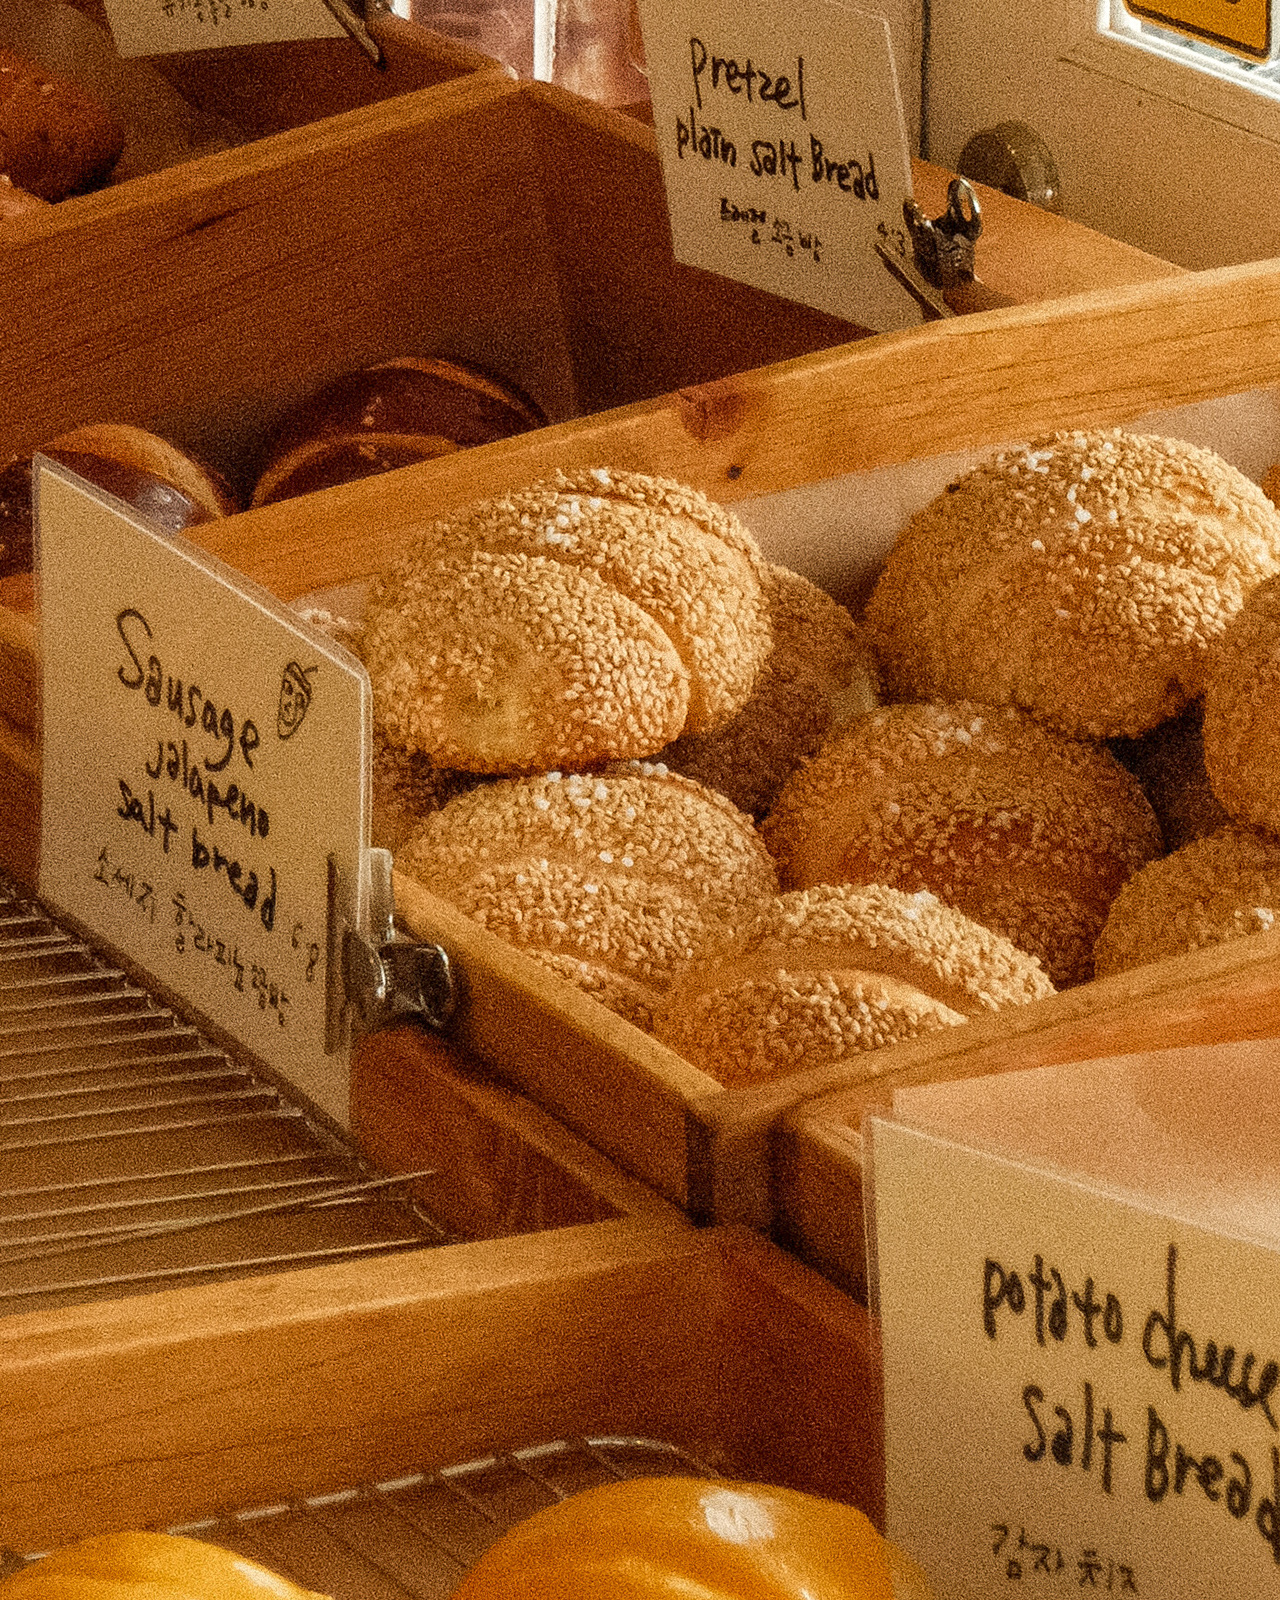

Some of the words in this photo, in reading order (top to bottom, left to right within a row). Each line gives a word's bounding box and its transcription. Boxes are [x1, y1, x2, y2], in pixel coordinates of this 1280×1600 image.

[691, 36, 807, 120] Pretzel
[116, 609, 261, 771] Sausage
[191, 828, 278, 932] bread
[983, 1253, 1125, 1349] potato
